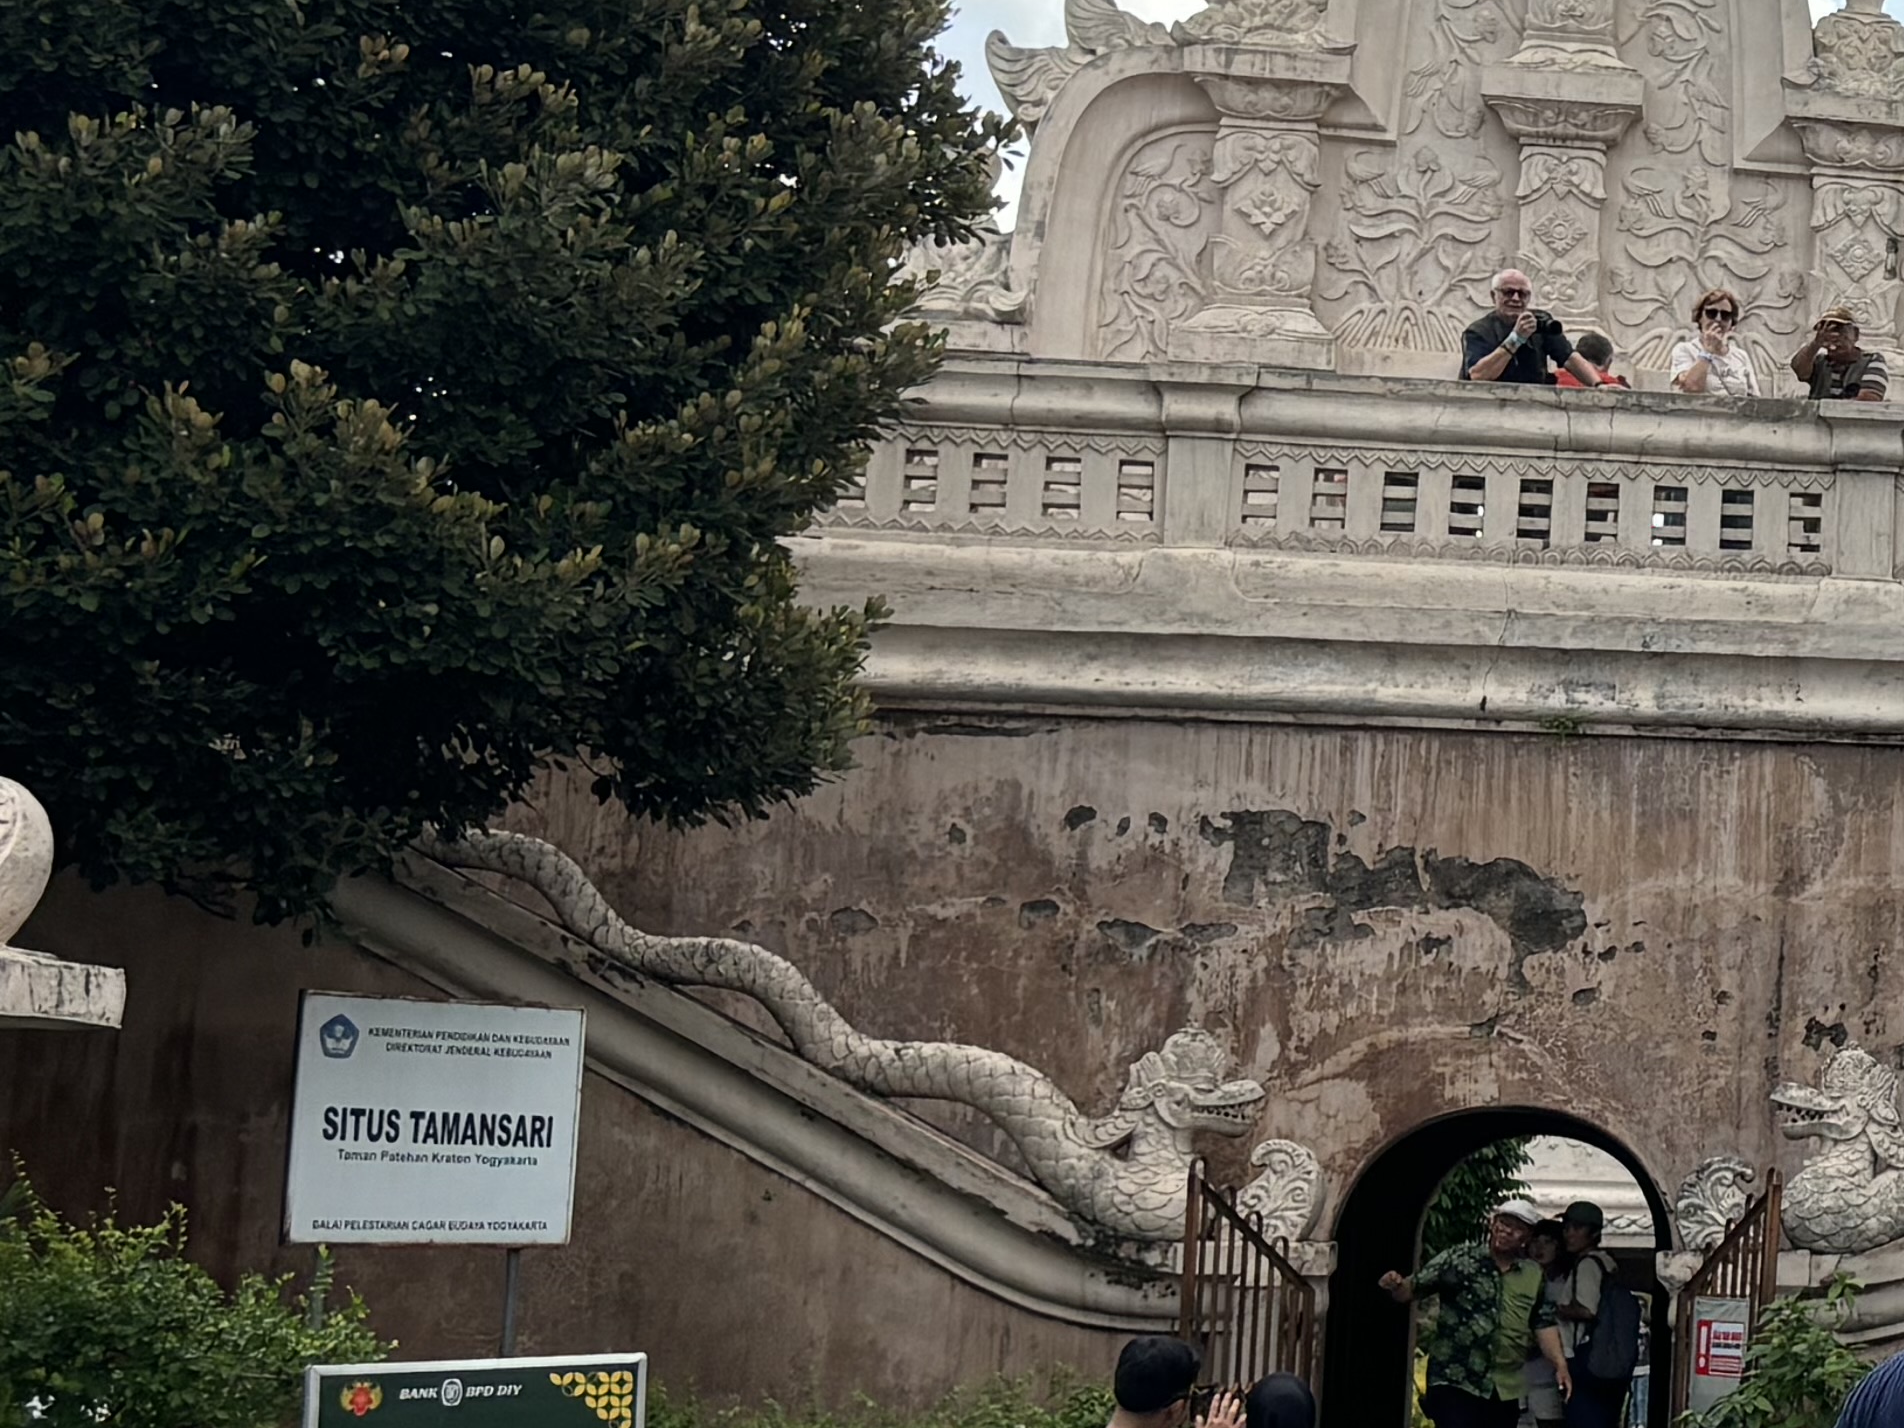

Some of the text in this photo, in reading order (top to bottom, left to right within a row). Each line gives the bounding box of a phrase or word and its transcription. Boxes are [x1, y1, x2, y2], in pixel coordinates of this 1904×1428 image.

[368, 1027, 433, 1039] KEMENTERIAN
[435, 1030, 490, 1042] PENDIDIKAN
[492, 1034, 510, 1044] DAN
[386, 1042, 442, 1054] DIREKTORAT
[444, 1045, 491, 1057] JENDERAL
[321, 1106, 554, 1149] SITUS TAMANSARI
[337, 1149, 538, 1168] Taman Patehan Kraton Yogyakarta
[312, 1219, 342, 1230] BALAI
[344, 1220, 409, 1230] PELESTARIAN
[399, 1384, 522, 1401] BANK BPD DIY
